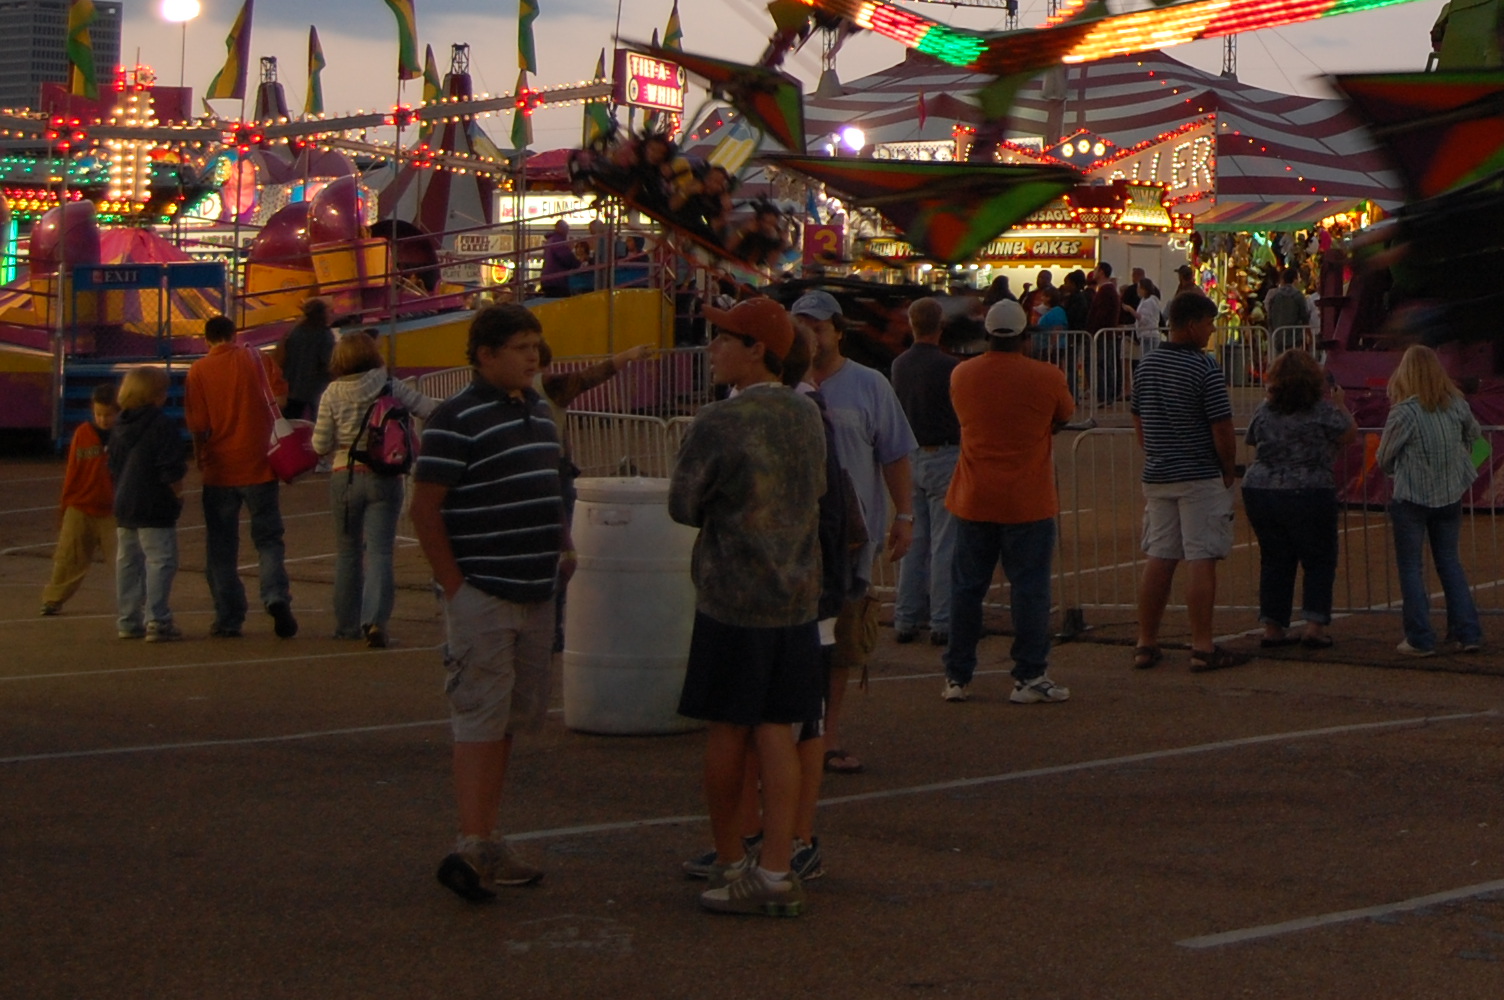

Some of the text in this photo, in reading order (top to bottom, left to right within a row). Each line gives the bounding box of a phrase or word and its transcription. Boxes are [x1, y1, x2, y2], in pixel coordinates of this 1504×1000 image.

[1028, 209, 1072, 222] USAGE
[813, 229, 837, 265] 3
[980, 240, 1081, 256] FUNNEL CAKES
[104, 270, 139, 282] EXIT
